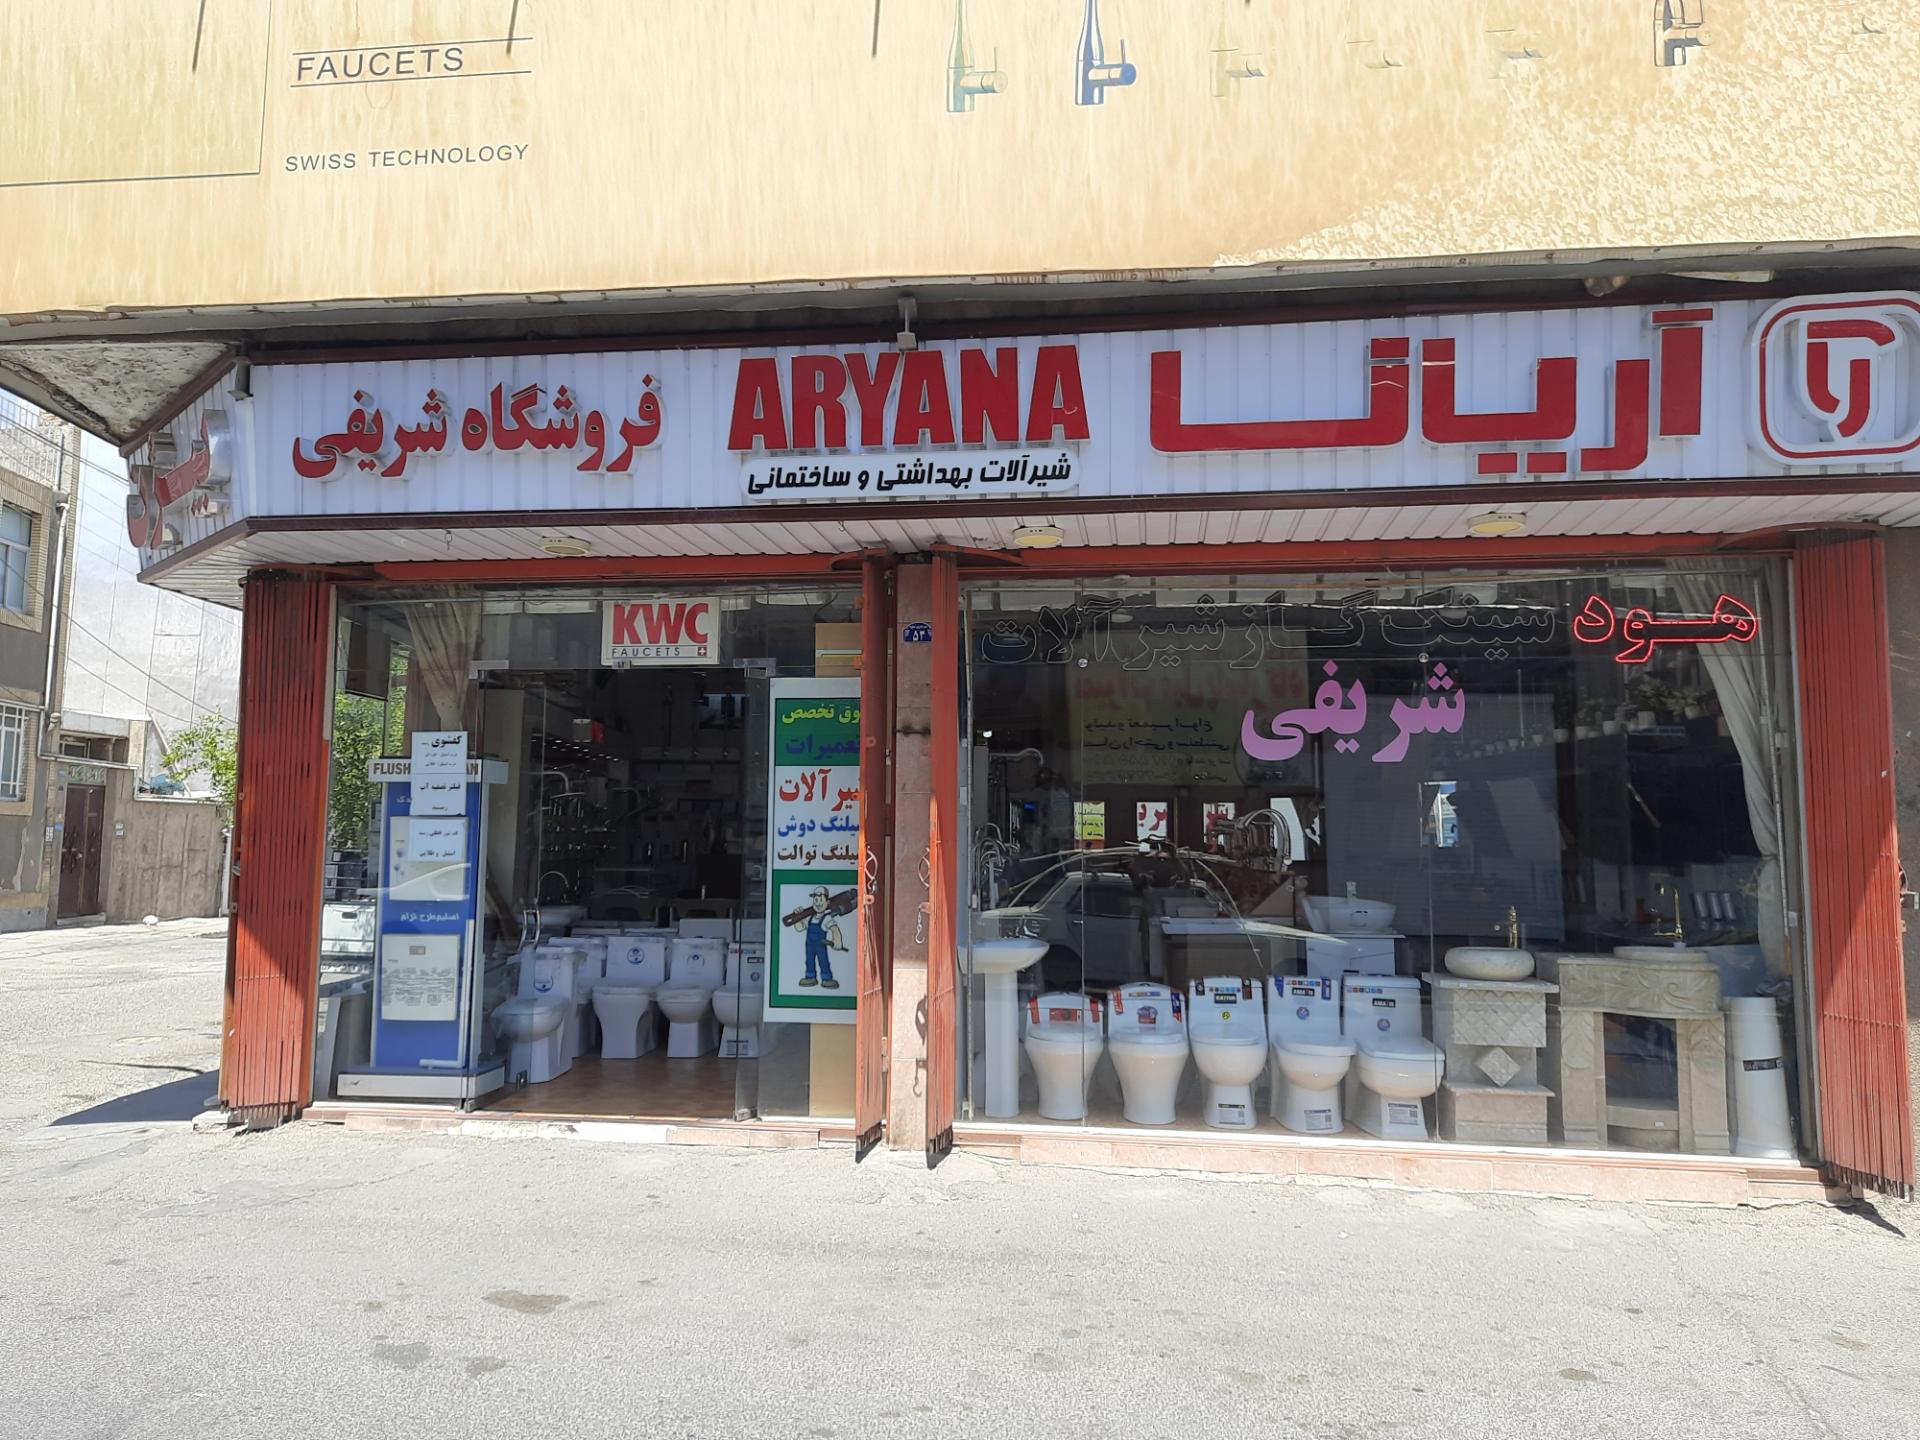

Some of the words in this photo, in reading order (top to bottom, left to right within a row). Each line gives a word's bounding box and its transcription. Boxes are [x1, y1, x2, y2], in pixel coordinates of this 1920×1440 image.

[297, 47, 465, 81] FAUCETS
[285, 152, 357, 172] SWISS
[368, 144, 530, 168] TECHNOLOGY
[727, 344, 1091, 451] ARYANA
[1150, 308, 1714, 474] آریانا
[292, 387, 448, 479] شریفی
[461, 373, 662, 473] فروشگاه
[748, 465, 851, 496] ساختمانی
[857, 467, 869, 491] و
[876, 457, 973, 492] بهداشتی
[612, 603, 709, 645] KWC
[1571, 593, 1760, 664] هود
[611, 647, 681, 657] FAUCETS
[782, 703, 835, 724] تخصص
[839, 706, 860, 724] وق
[1241, 660, 1466, 762] شریفی
[373, 762, 411, 775] FLUSH
[779, 768, 832, 802] آلات
[832, 778, 862, 812] یر
[777, 815, 816, 837] دوش
[820, 815, 860, 837] یلنگ
[777, 845, 817, 866] توالت
[821, 845, 859, 866] یلنگ
